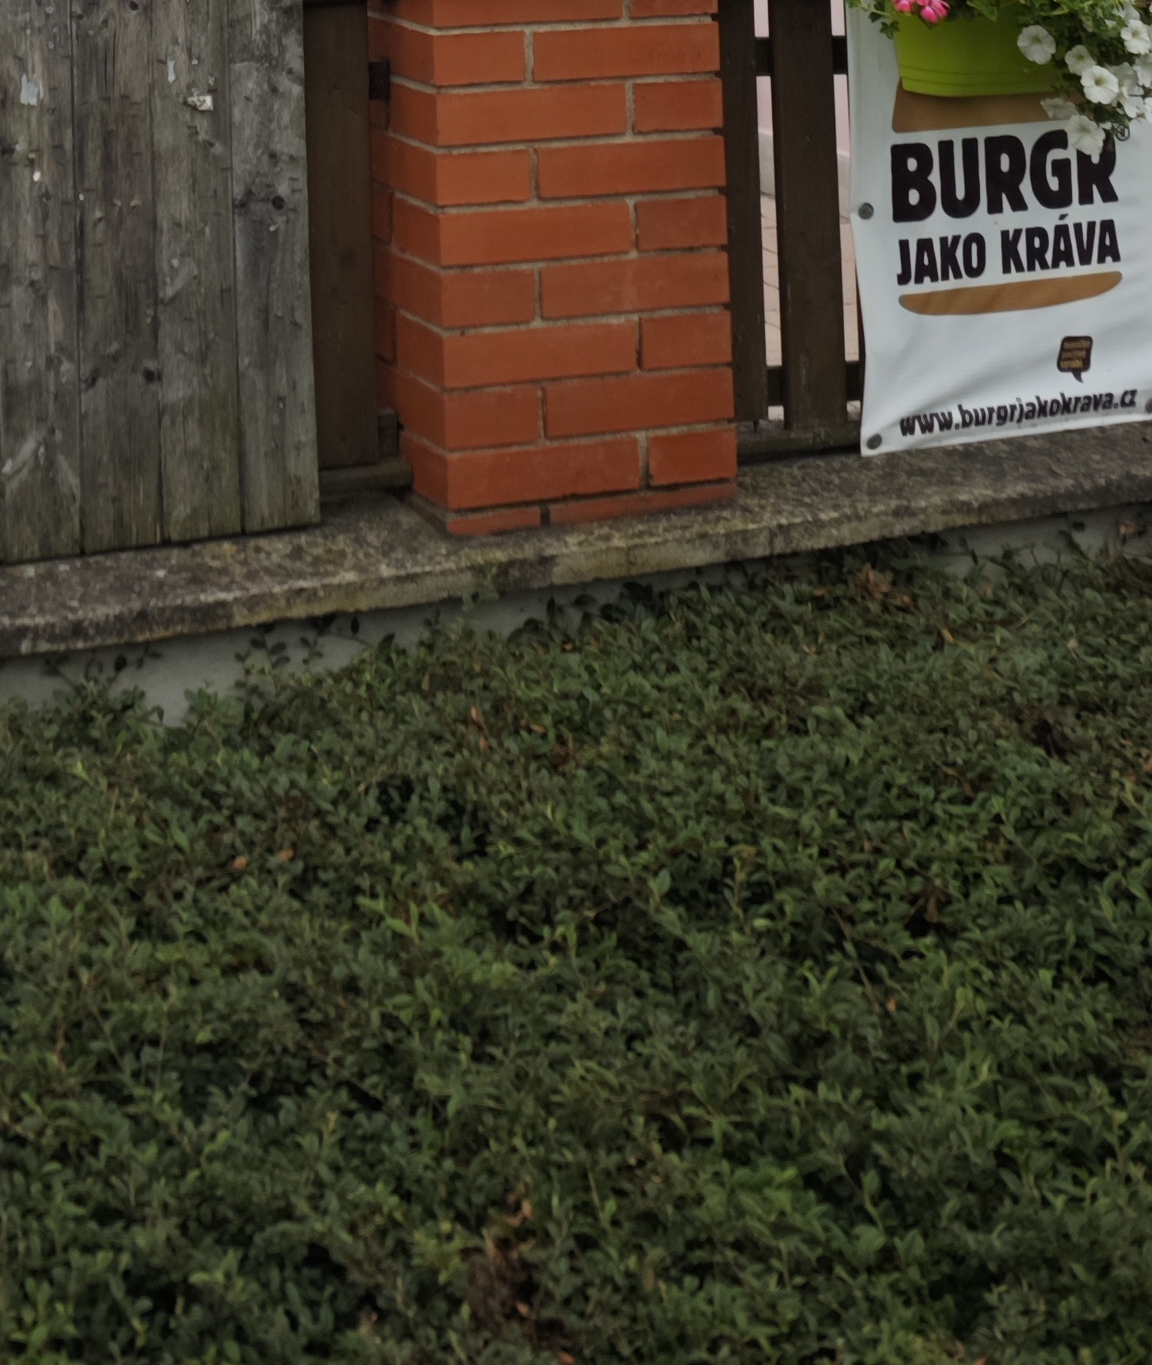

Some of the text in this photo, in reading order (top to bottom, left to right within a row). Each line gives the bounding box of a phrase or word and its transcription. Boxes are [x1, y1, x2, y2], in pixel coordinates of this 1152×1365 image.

[890, 128, 1120, 223] BURGR
[897, 213, 1121, 286] JAKO KRÁVA
[899, 388, 1138, 437] www.burgrjakokrava.cz
